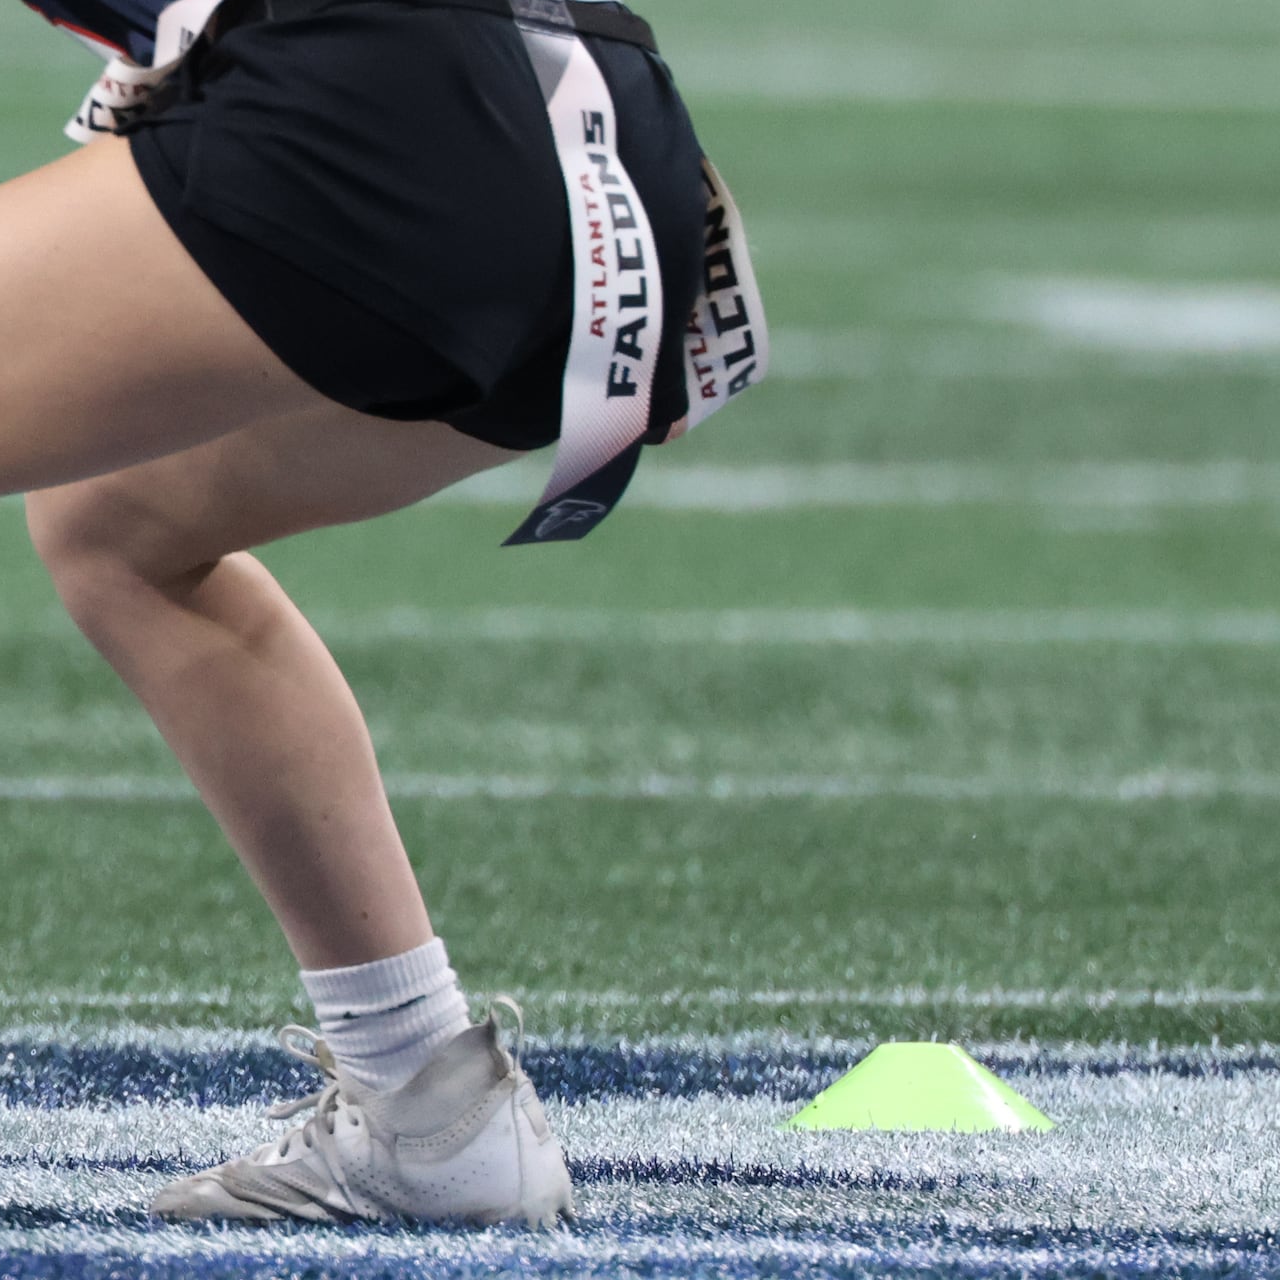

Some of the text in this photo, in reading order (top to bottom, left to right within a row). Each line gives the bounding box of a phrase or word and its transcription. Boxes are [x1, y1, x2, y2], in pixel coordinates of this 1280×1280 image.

[579, 173, 608, 339] ATLANTA
[581, 108, 647, 400] FALCONS
[701, 169, 757, 397] ALCON
